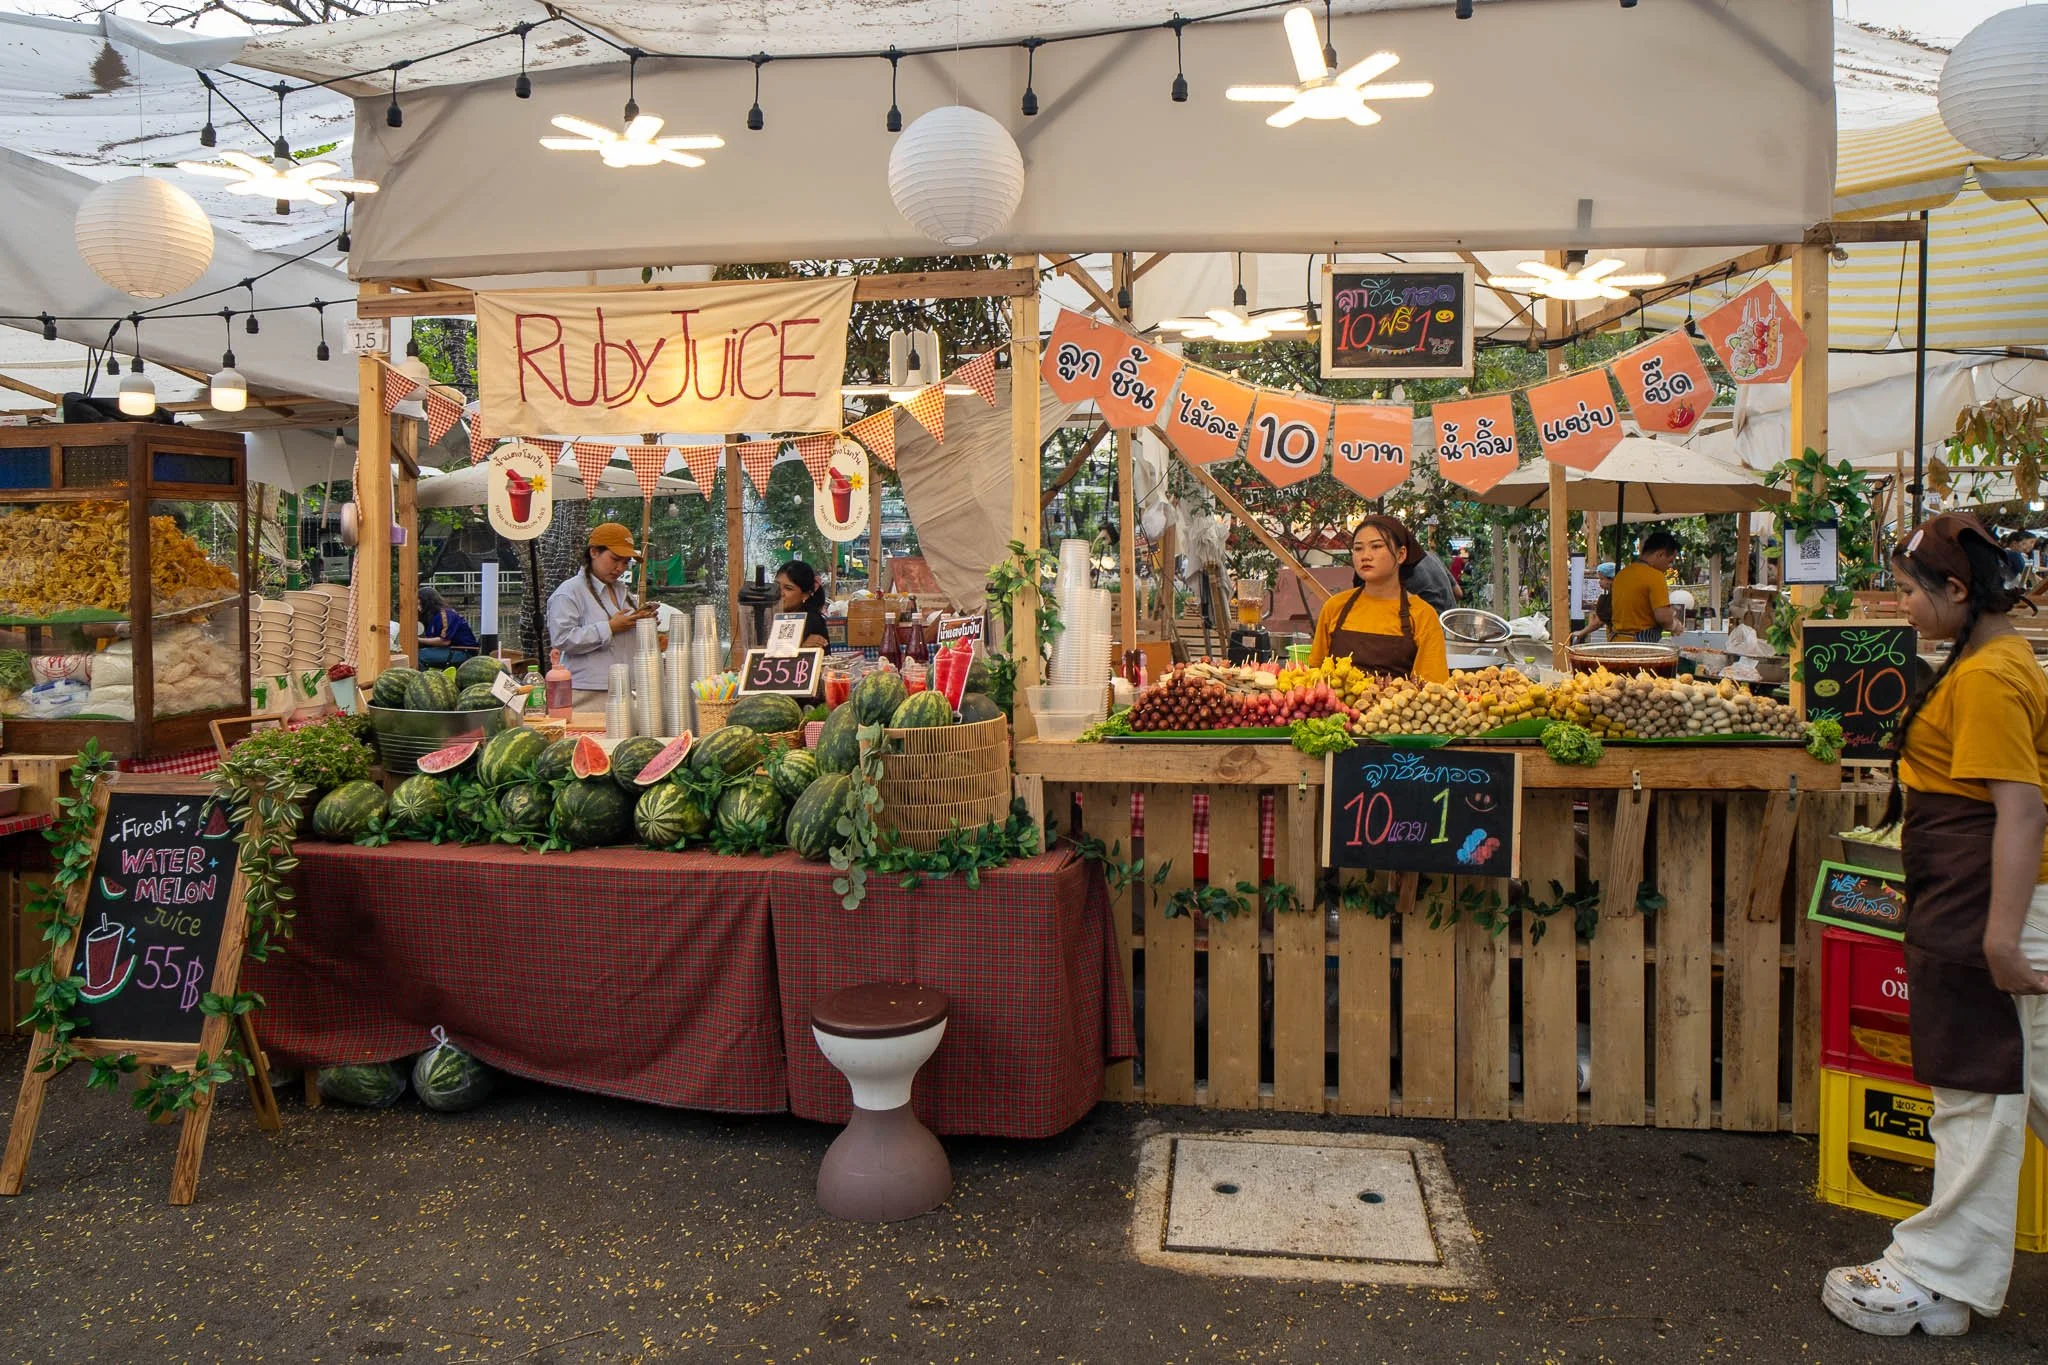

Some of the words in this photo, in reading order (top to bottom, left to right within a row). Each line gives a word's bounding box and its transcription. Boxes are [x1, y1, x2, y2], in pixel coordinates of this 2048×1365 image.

[355, 332, 376, 349] 1.5
[1337, 312, 1377, 351] 10
[1377, 305, 1417, 338] ฟรี
[1413, 308, 1432, 352] 1
[1056, 342, 1102, 382] ลูก
[1111, 346, 1156, 412] ชิ้น
[1178, 391, 1240, 442] ไม้ละ
[1259, 415, 1316, 465] 10
[1340, 442, 1404, 465] บาท
[1439, 417, 1514, 461] น้ำจิ้ม
[1542, 402, 1615, 443] แซ่บ
[1805, 629, 1906, 673] ลูกชิ้น
[1843, 667, 1906, 718] 10
[1361, 752, 1491, 789] ลูกชิ้นทอด
[121, 810, 173, 842] Fresh
[1343, 791, 1393, 847] 10
[1430, 788, 1450, 845] 1
[121, 846, 206, 875] WATER
[134, 874, 217, 905] MELON
